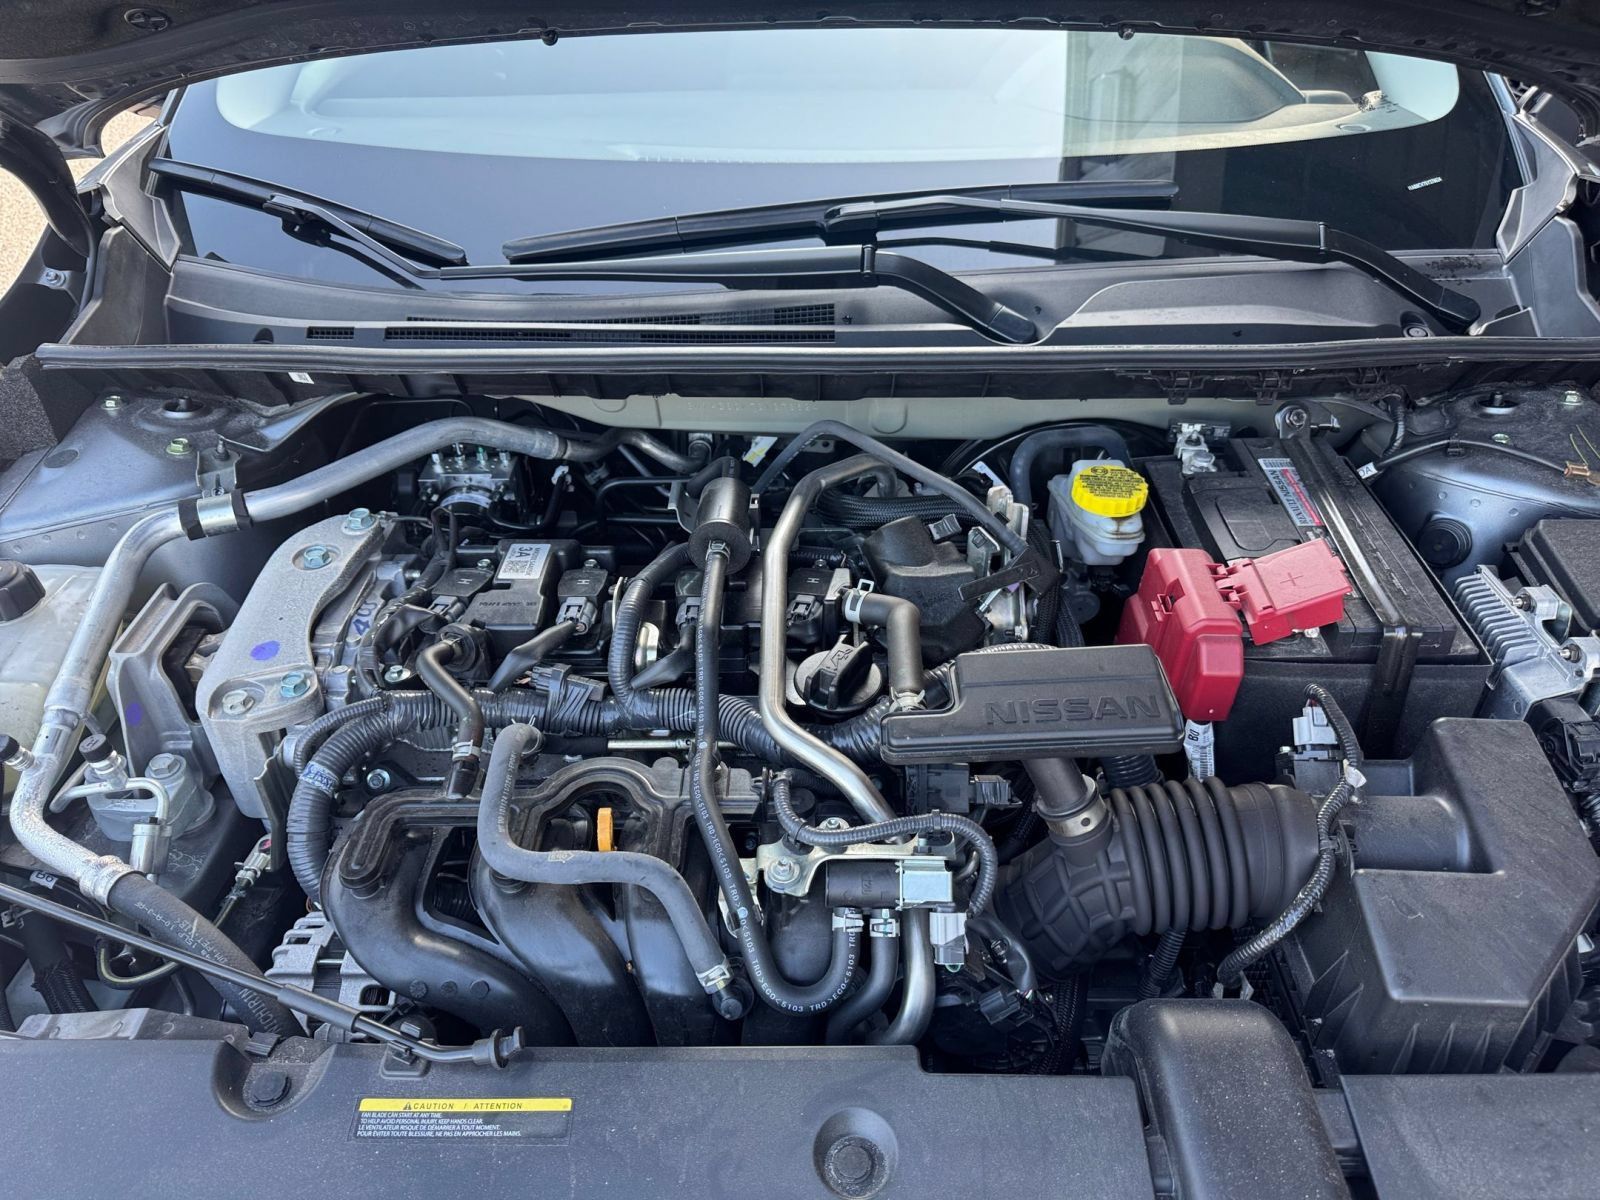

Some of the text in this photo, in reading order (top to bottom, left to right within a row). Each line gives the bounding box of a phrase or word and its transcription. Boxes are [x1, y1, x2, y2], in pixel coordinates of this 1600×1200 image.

[1268, 469, 1291, 496] NISSAN
[516, 547, 532, 557] 3A
[985, 694, 1161, 726] NISSAN
[238, 987, 280, 1032] NICHIRIN
